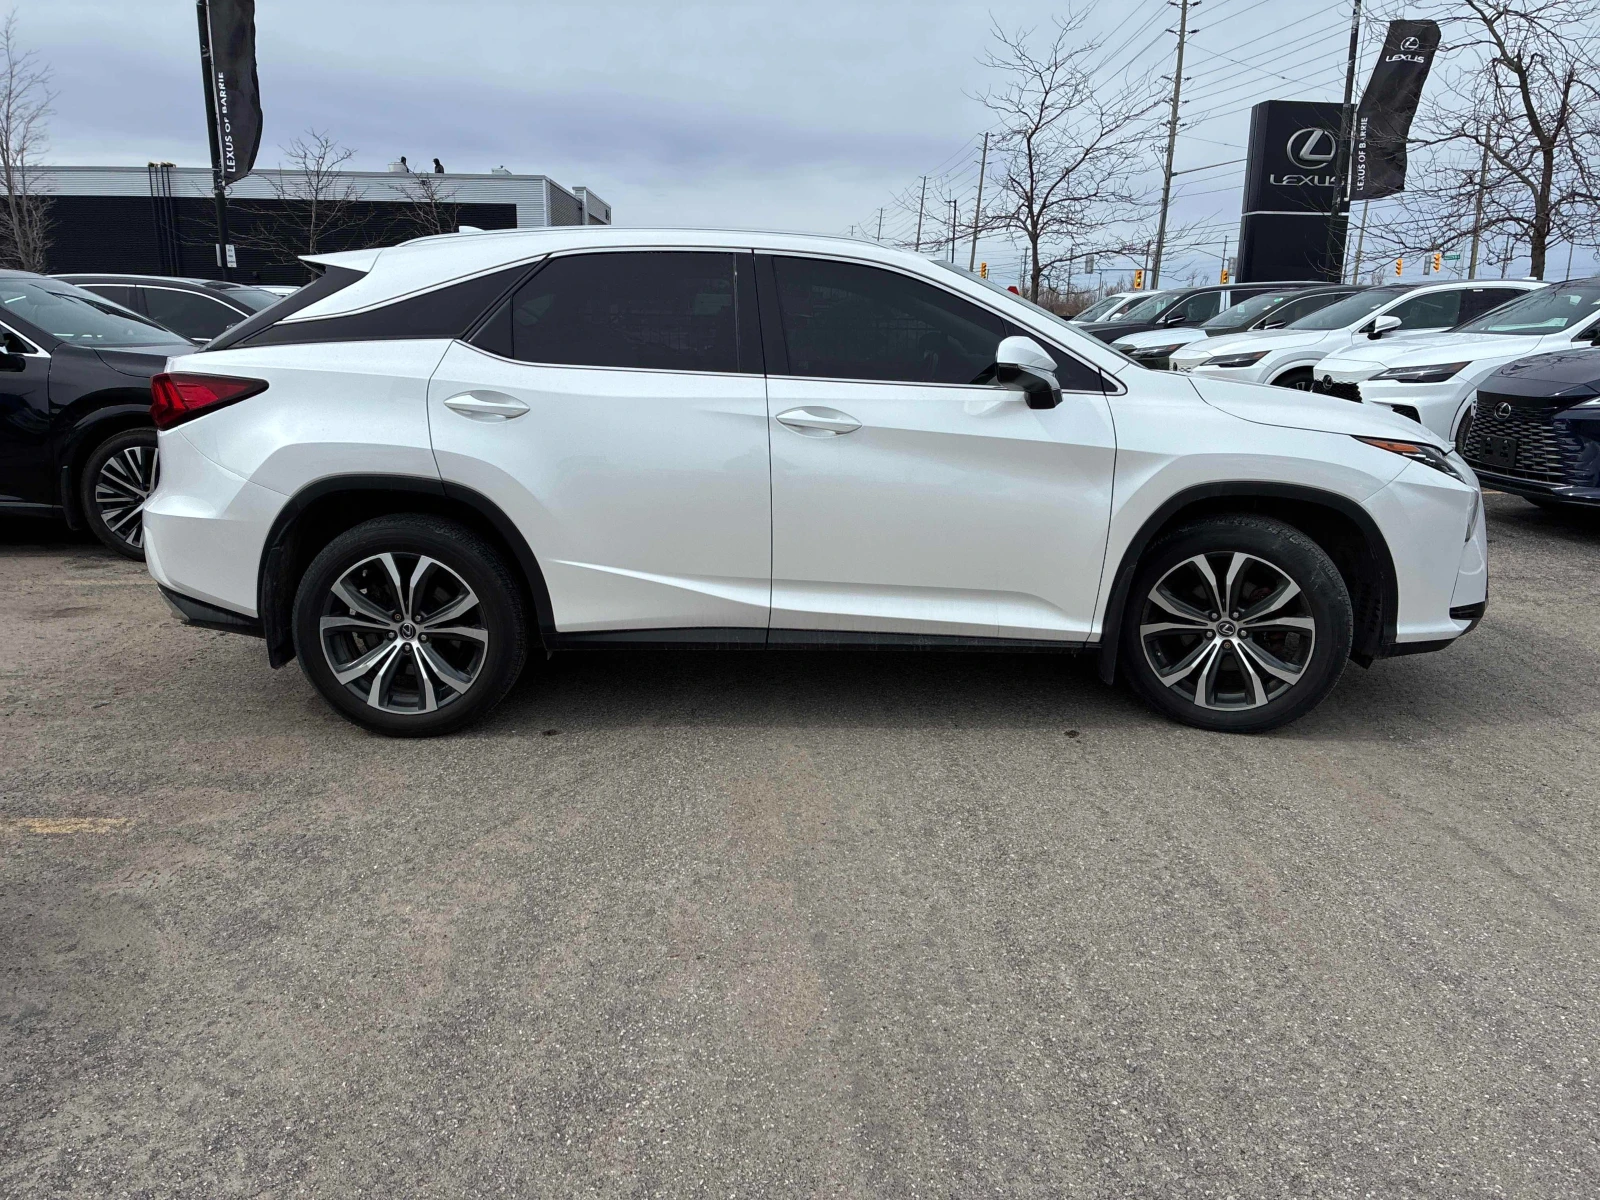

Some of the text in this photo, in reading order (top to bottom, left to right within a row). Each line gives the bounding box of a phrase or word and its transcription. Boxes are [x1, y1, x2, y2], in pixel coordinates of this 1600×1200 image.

[1385, 53, 1425, 64] LEXUS
[218, 72, 235, 172] LEXUS OF BARRIE
[1358, 150, 1367, 163] OF
[1356, 164, 1366, 191] LEXUS
